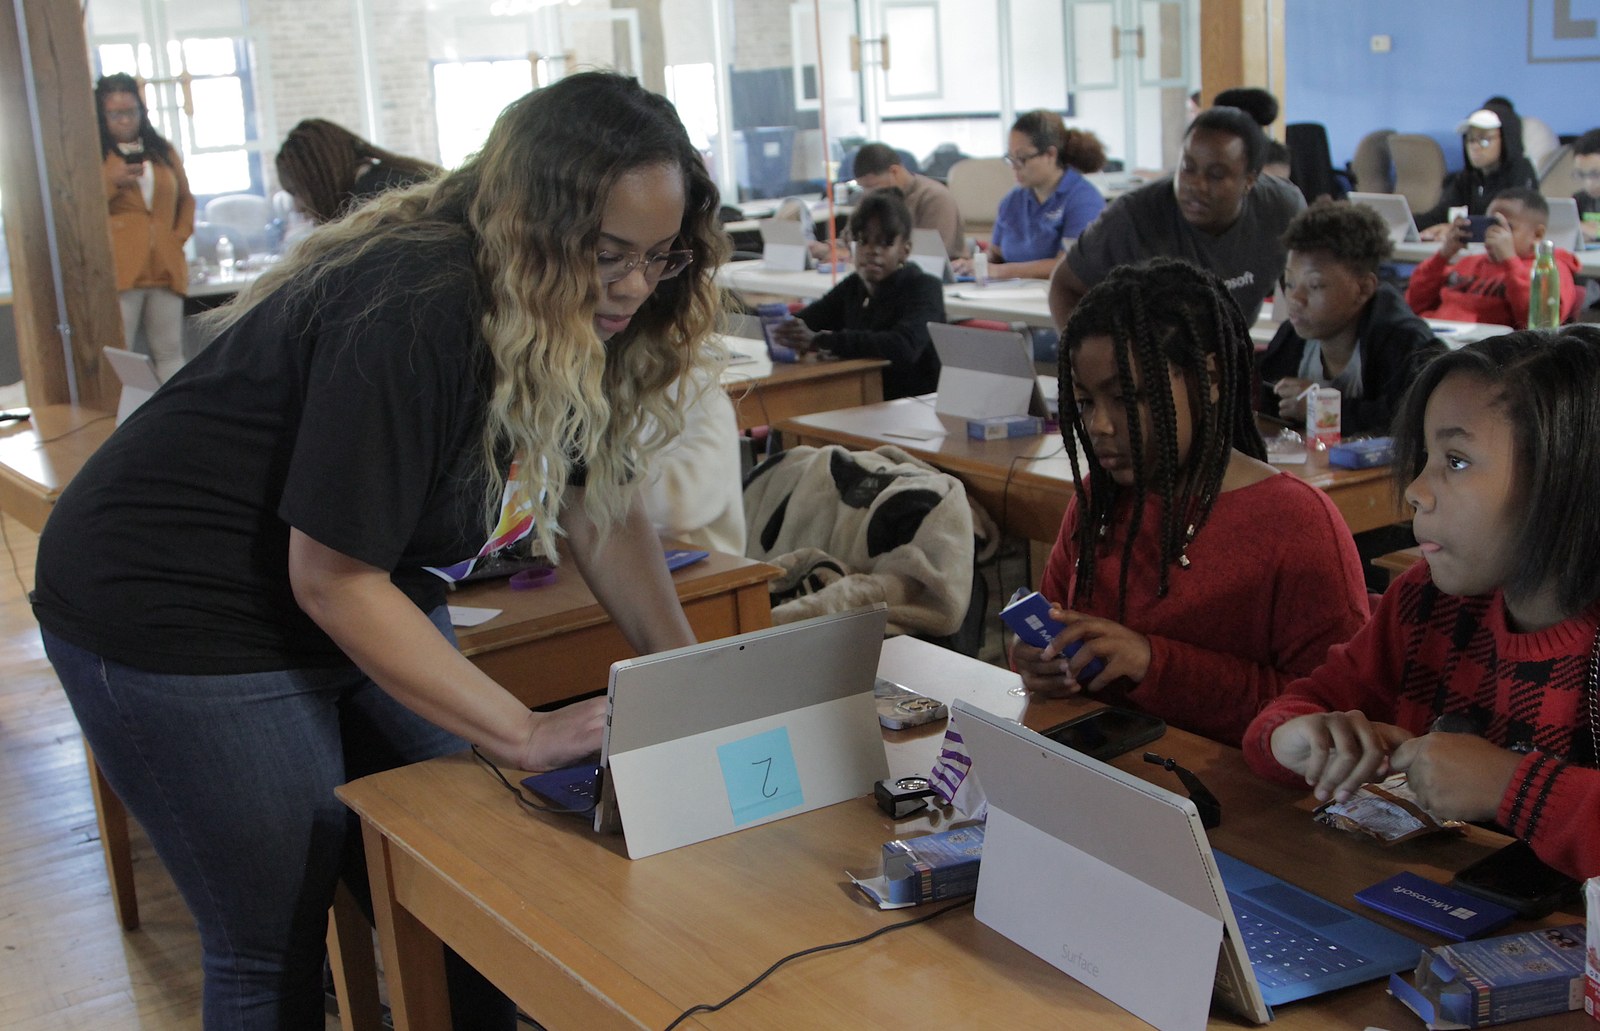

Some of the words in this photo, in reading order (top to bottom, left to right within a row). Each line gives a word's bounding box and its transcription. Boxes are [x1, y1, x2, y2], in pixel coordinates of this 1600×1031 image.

[1039, 629, 1055, 643] Mi
[1393, 886, 1453, 911] Microsoft
[1061, 944, 1100, 978] Surface
